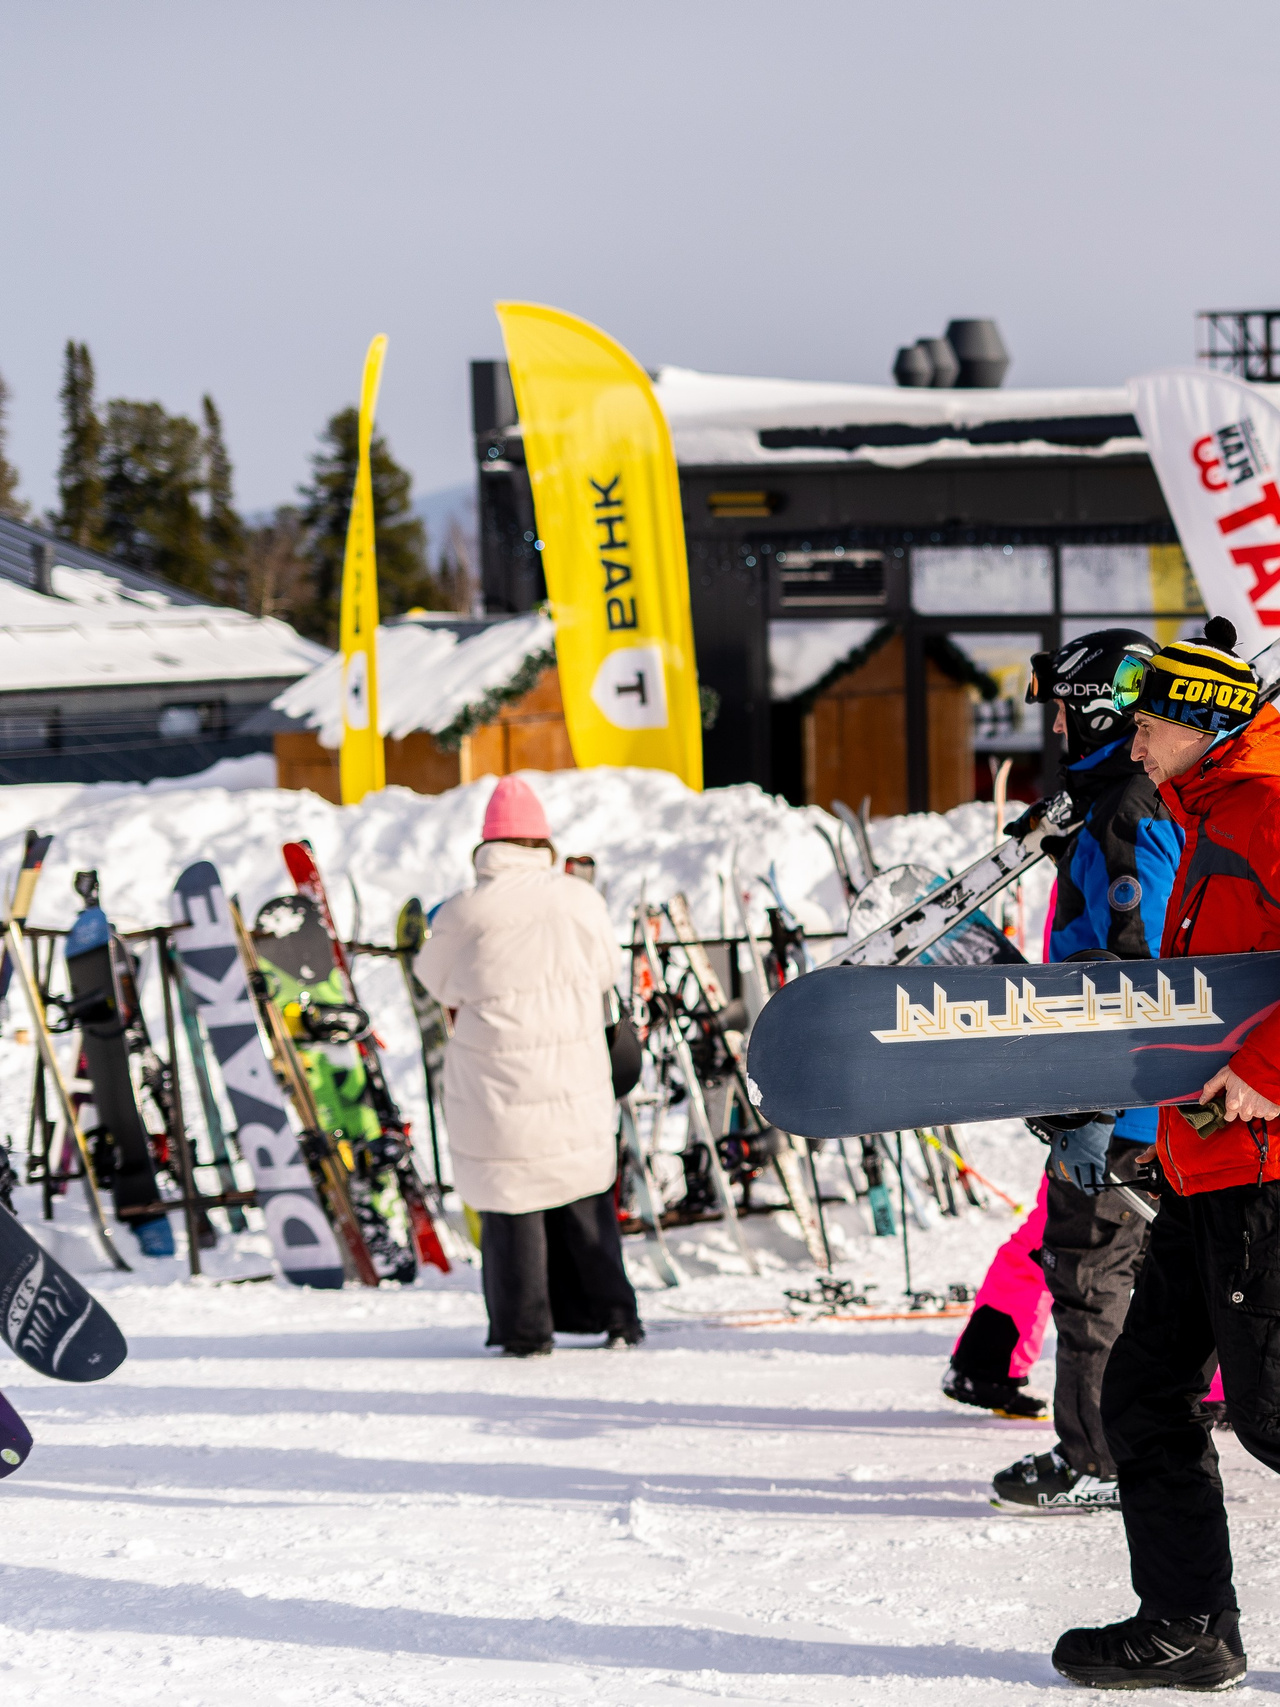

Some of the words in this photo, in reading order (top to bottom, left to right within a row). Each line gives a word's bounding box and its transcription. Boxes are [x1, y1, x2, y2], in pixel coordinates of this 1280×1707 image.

[1073, 683, 1114, 696] DRA
[1150, 699, 1230, 732] NIKE
[869, 966, 1226, 1044] FREESPORT
[172, 884, 345, 1269] DRAKE
